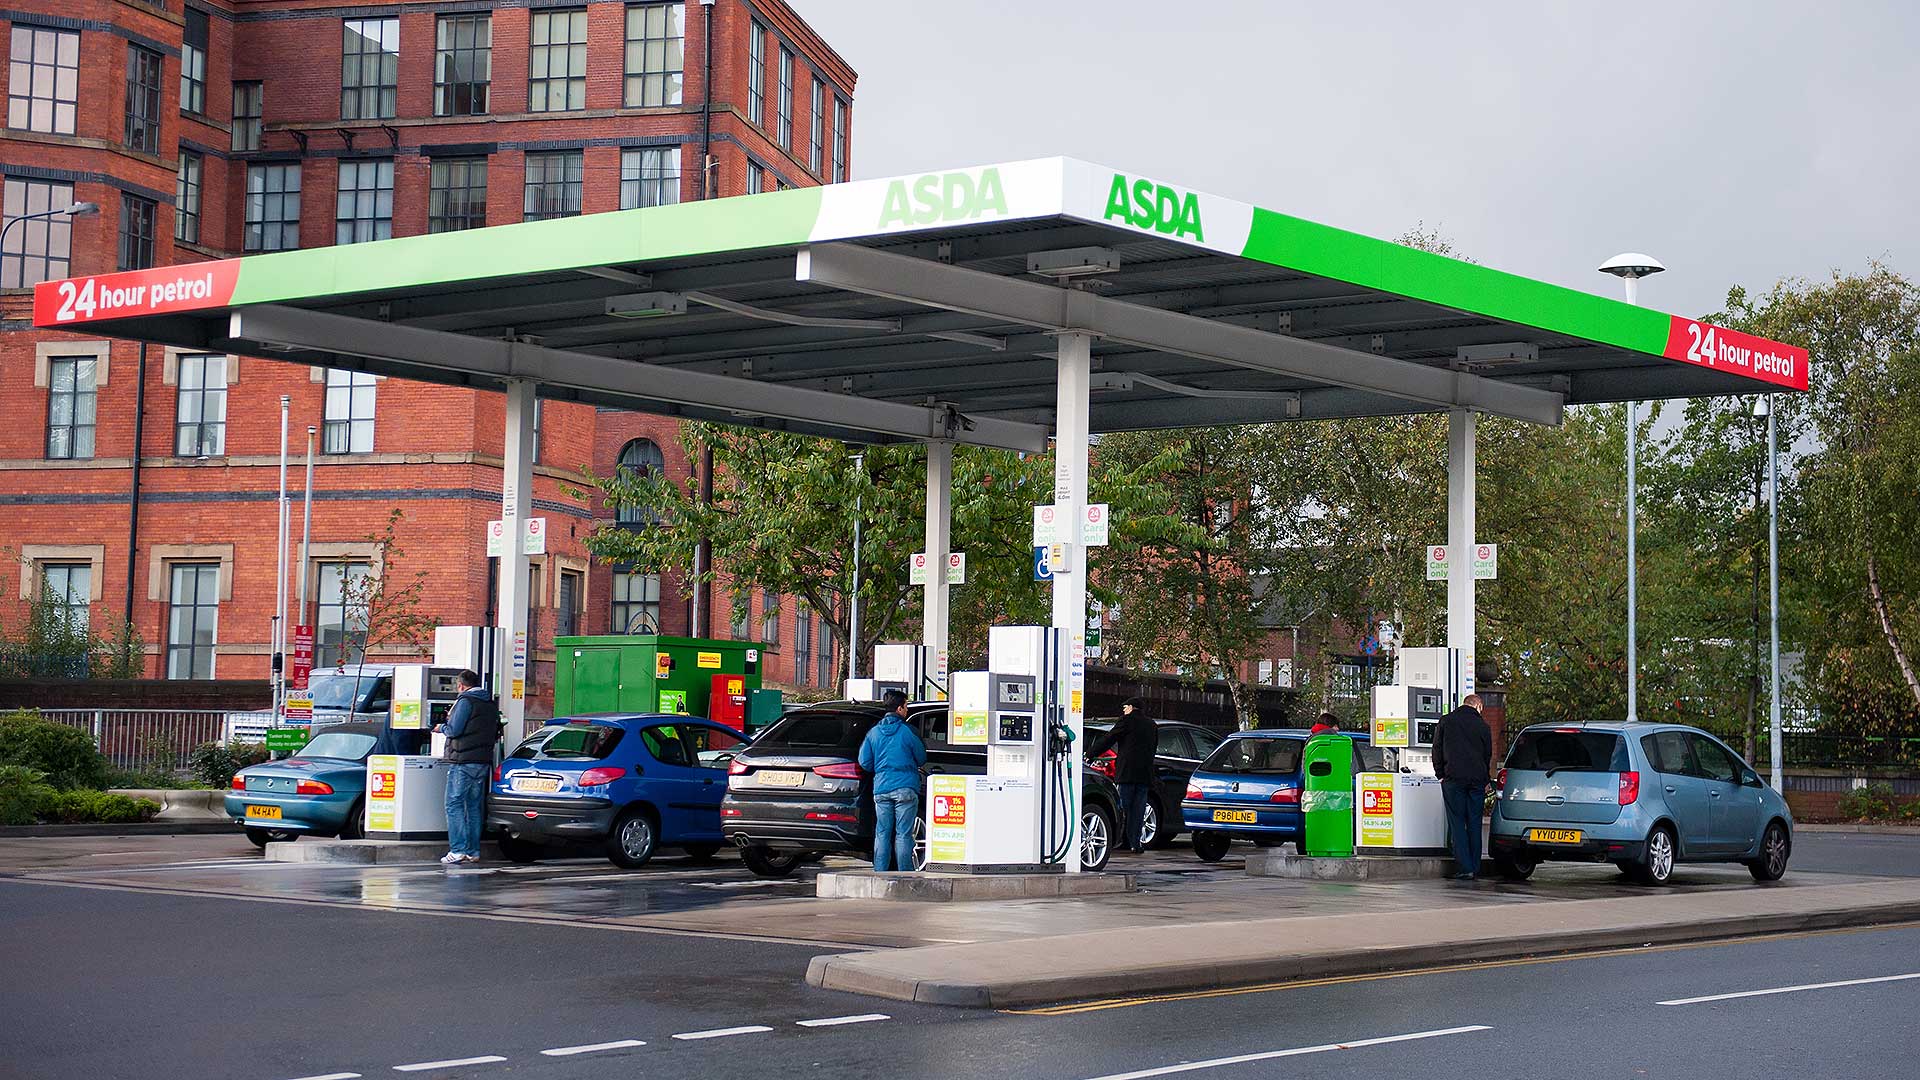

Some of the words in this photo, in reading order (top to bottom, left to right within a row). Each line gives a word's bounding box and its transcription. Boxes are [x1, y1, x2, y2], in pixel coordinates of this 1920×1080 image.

[878, 167, 1008, 230] ASDA
[1103, 173, 1205, 244] ASDA
[56, 279, 97, 321] 24
[99, 285, 146, 309] hour
[150, 272, 213, 308] petrol
[1686, 323, 1717, 366] 24
[1719, 337, 1751, 367] hour
[1753, 351, 1794, 378] petrol
[1083, 524, 1104, 532] Card
[1084, 533, 1104, 543] only
[1431, 570, 1448, 578] only
[1475, 569, 1493, 577] only
[252, 807, 261, 816] N4
[262, 807, 277, 817] HAY
[1215, 811, 1234, 820] P961
[1235, 812, 1253, 821] LNE
[1536, 830, 1556, 839] YY10
[1557, 831, 1576, 841] UFS
